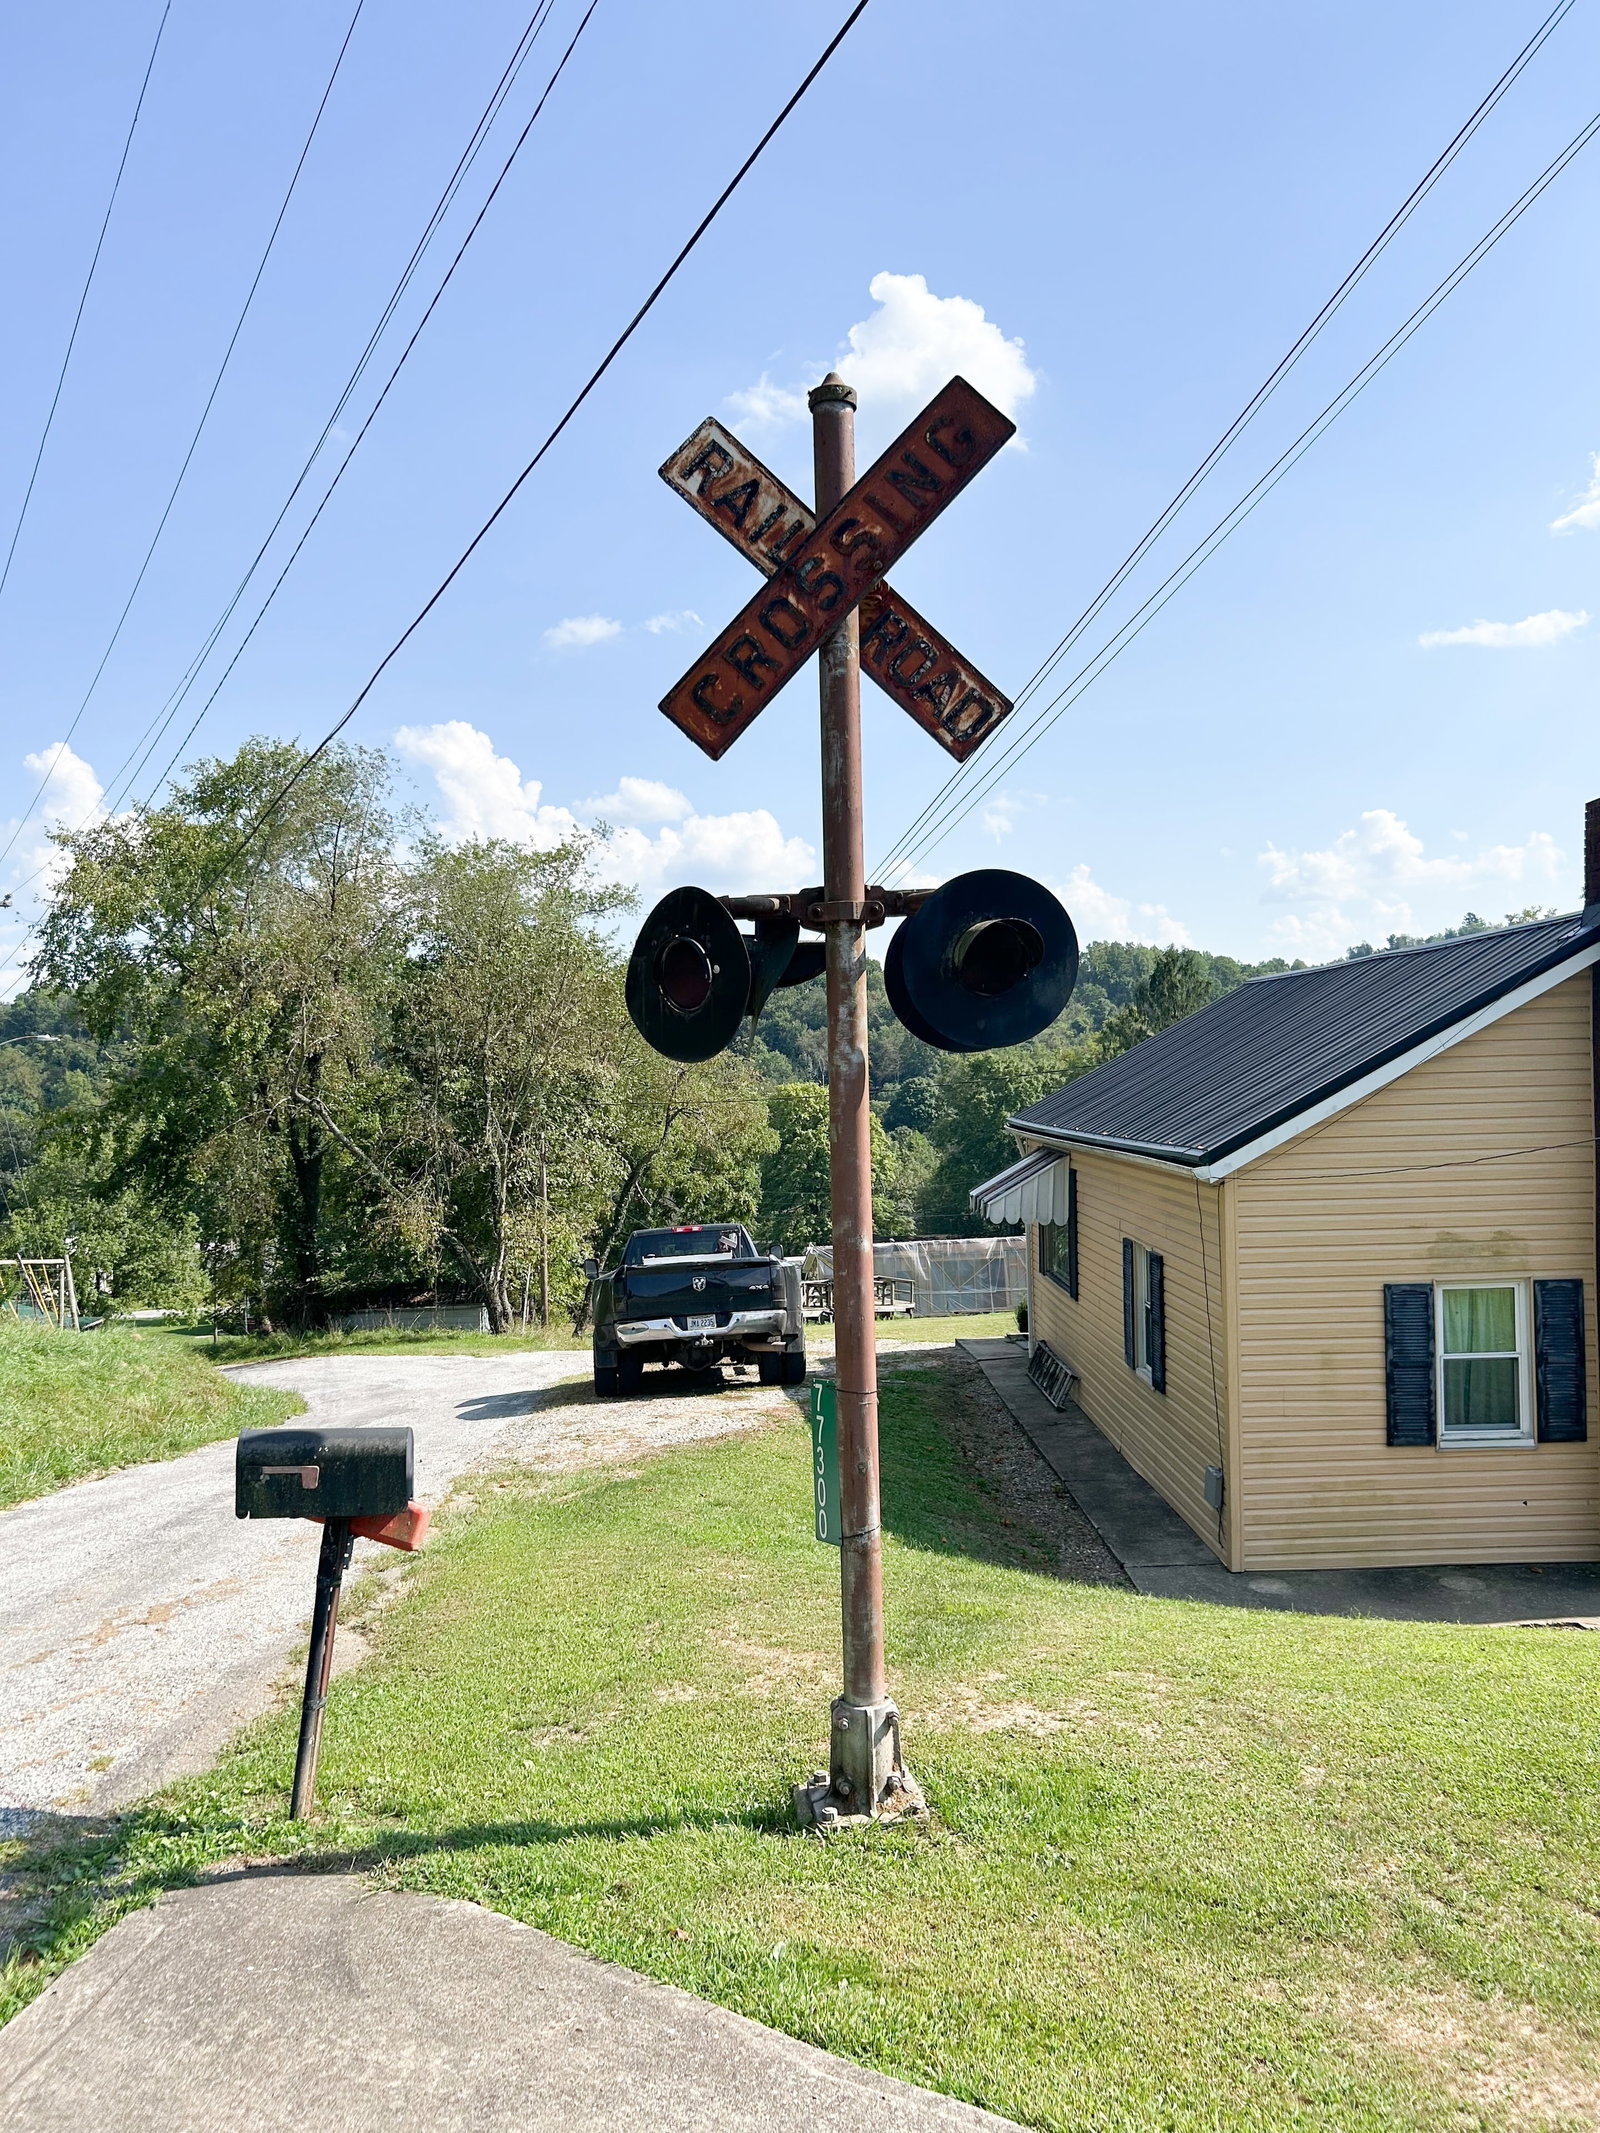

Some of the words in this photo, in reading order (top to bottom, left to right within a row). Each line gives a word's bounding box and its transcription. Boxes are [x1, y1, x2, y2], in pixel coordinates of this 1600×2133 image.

[681, 438, 806, 566] RAIL
[861, 608, 998, 742] ROAD
[692, 414, 978, 726] CROSSING
[813, 1383, 828, 1539] 77300
